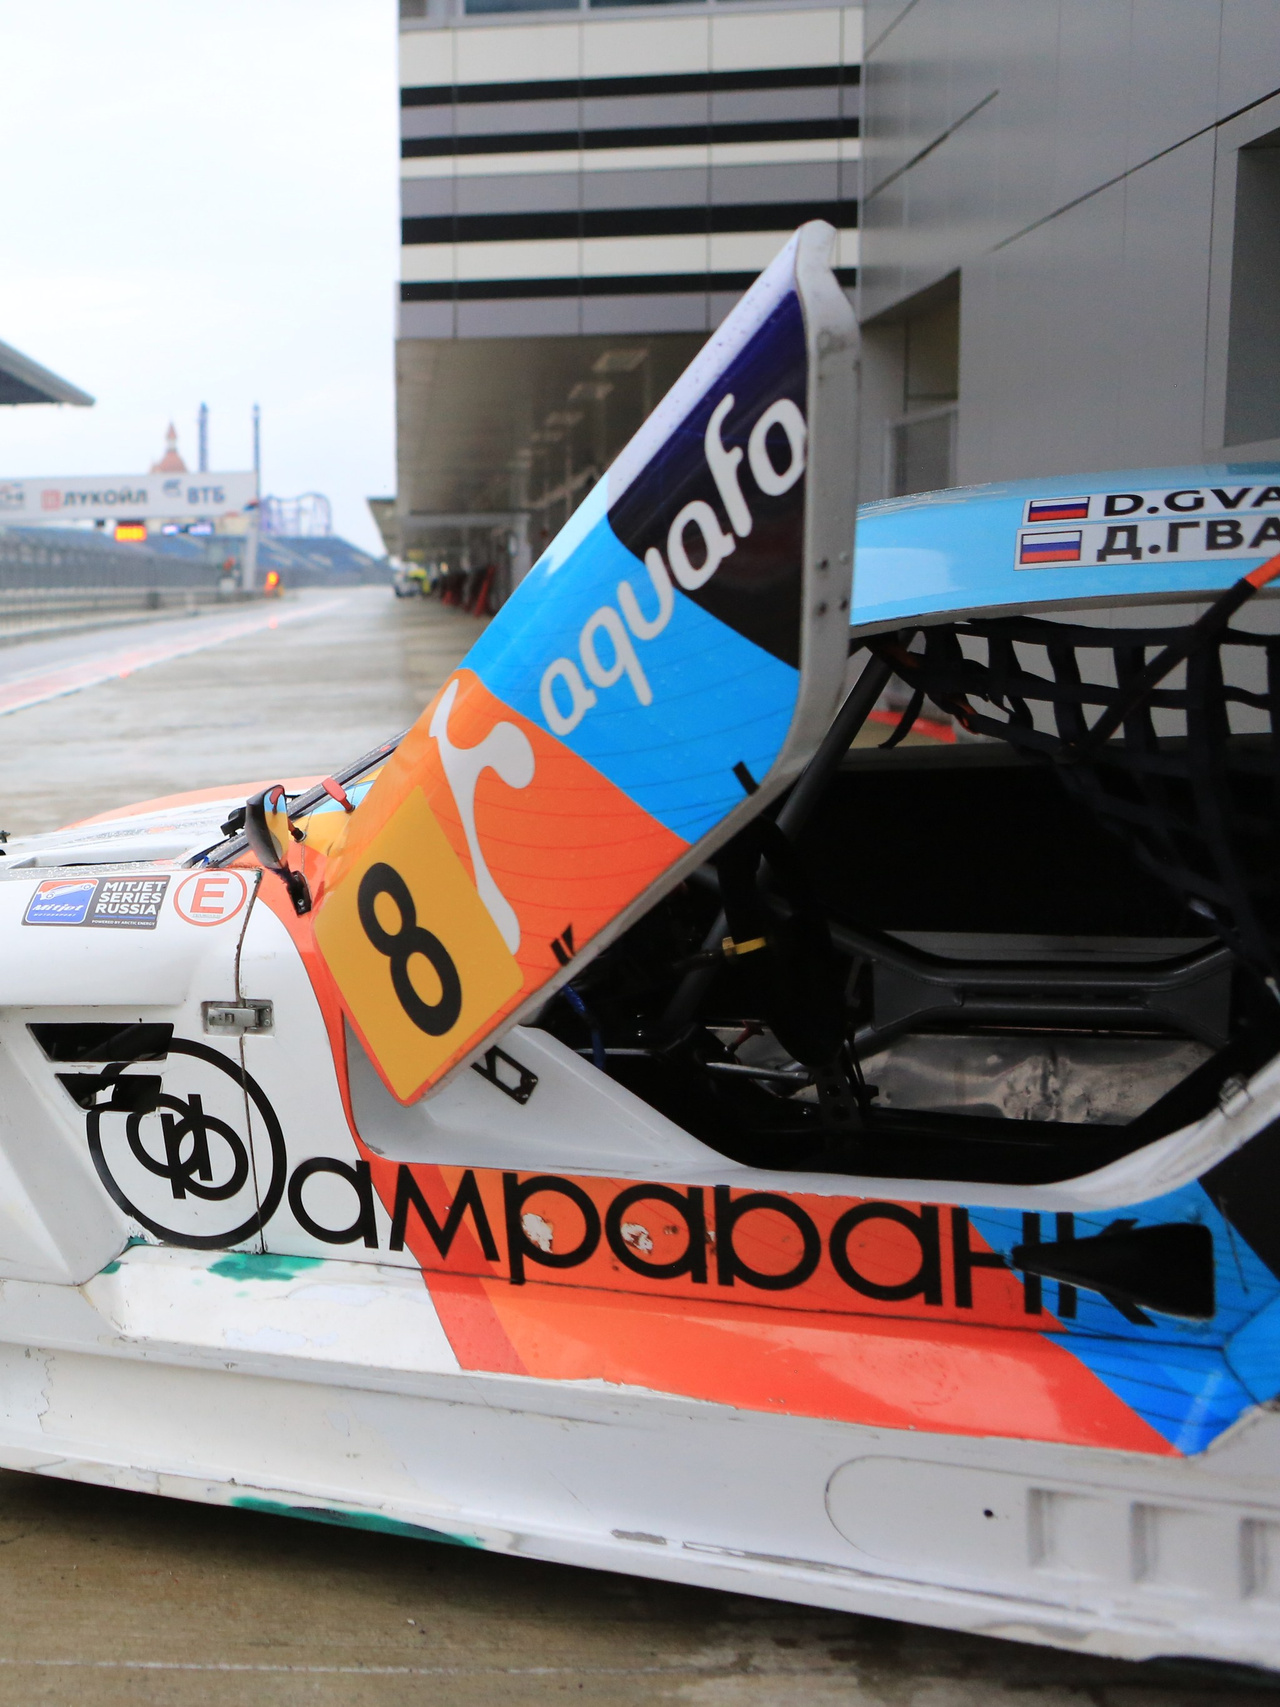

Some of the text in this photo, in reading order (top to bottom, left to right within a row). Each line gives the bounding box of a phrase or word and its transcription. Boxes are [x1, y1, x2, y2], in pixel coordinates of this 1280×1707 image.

[64, 487, 148, 506] ЛУКОЙЛ
[188, 486, 225, 504] ВТБ
[539, 393, 807, 735] aquafo
[103, 881, 167, 892] MITJET
[99, 892, 162, 904] SERIES
[190, 878, 230, 914] E
[32, 904, 84, 912] Mitjet
[94, 903, 157, 915] RUSSIA
[357, 862, 462, 1037] 8
